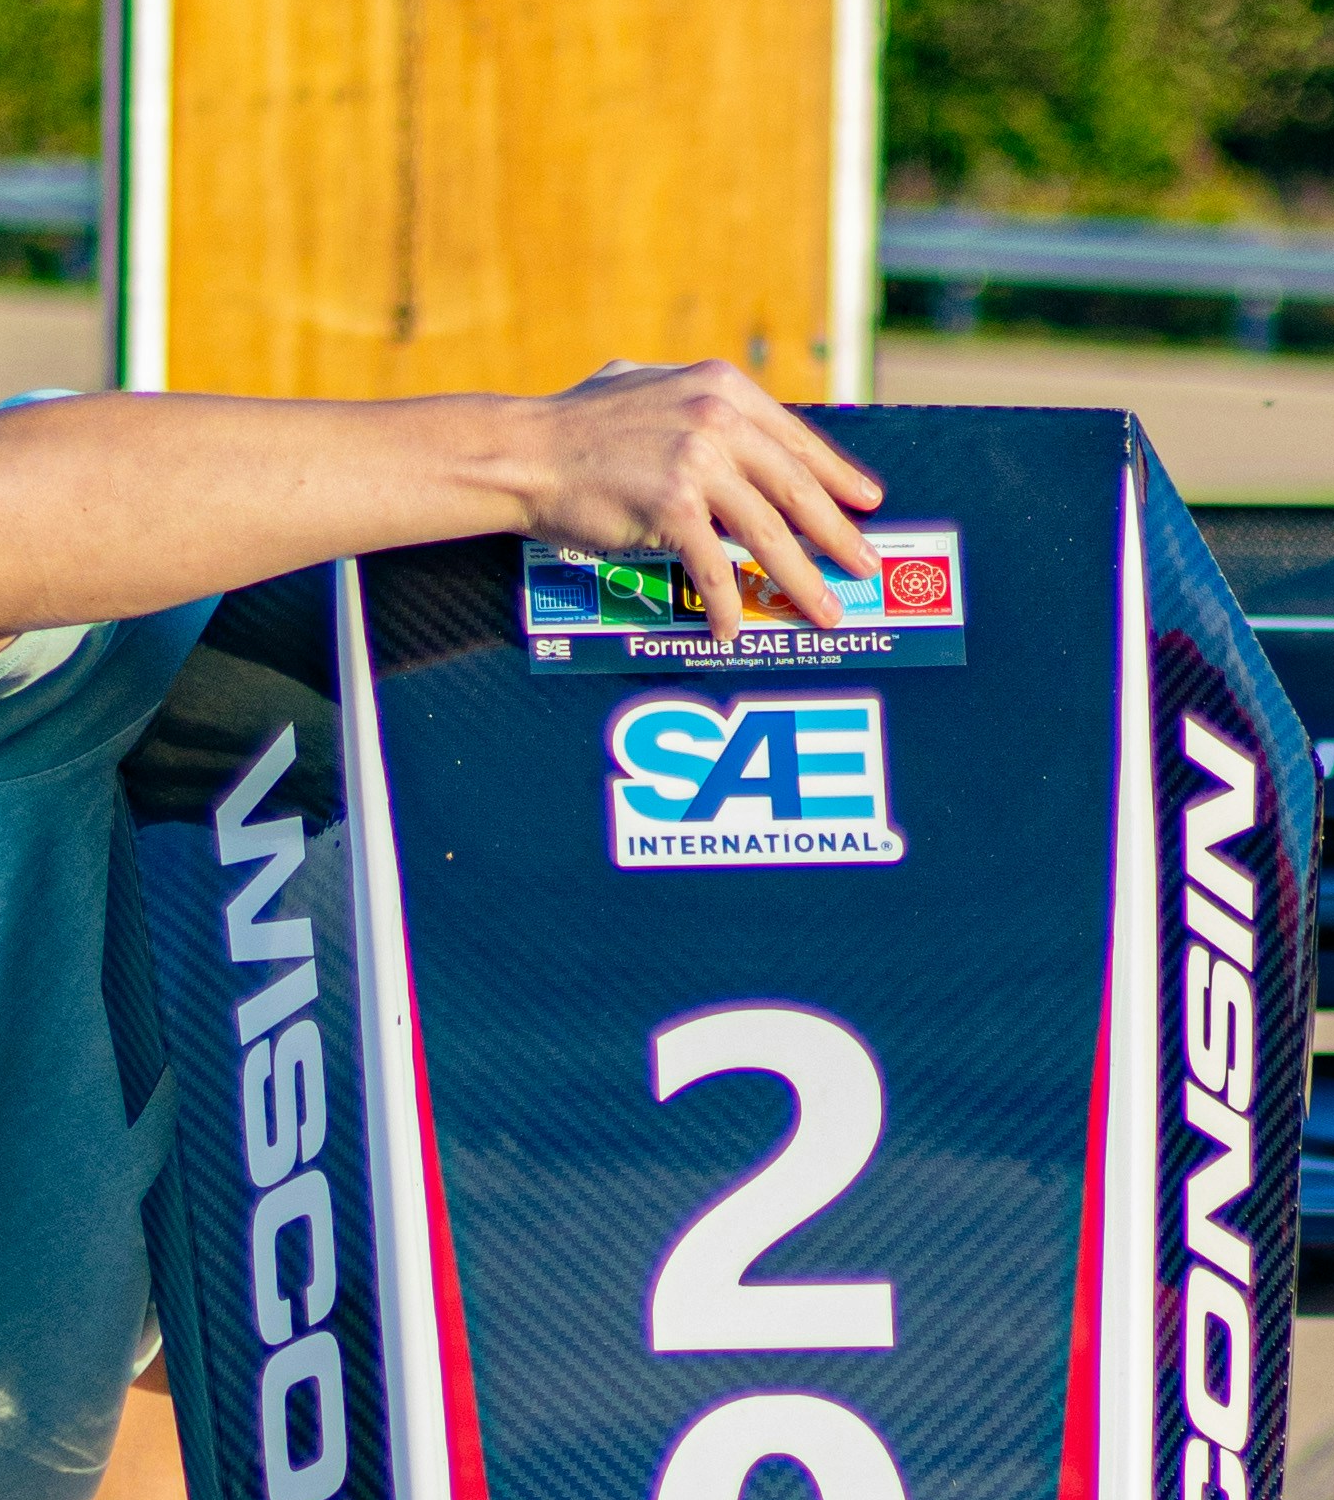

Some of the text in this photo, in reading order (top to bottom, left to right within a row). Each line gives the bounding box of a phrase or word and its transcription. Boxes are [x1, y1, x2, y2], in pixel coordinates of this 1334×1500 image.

[536, 639, 571, 656] SAE
[630, 631, 892, 657] Formula SAE Electric
[726, 657, 764, 667] Michigan
[774, 657, 794, 665] June
[820, 655, 842, 664] 2025
[622, 709, 875, 822] SAE
[628, 832, 879, 856] INTERNATIONAL
